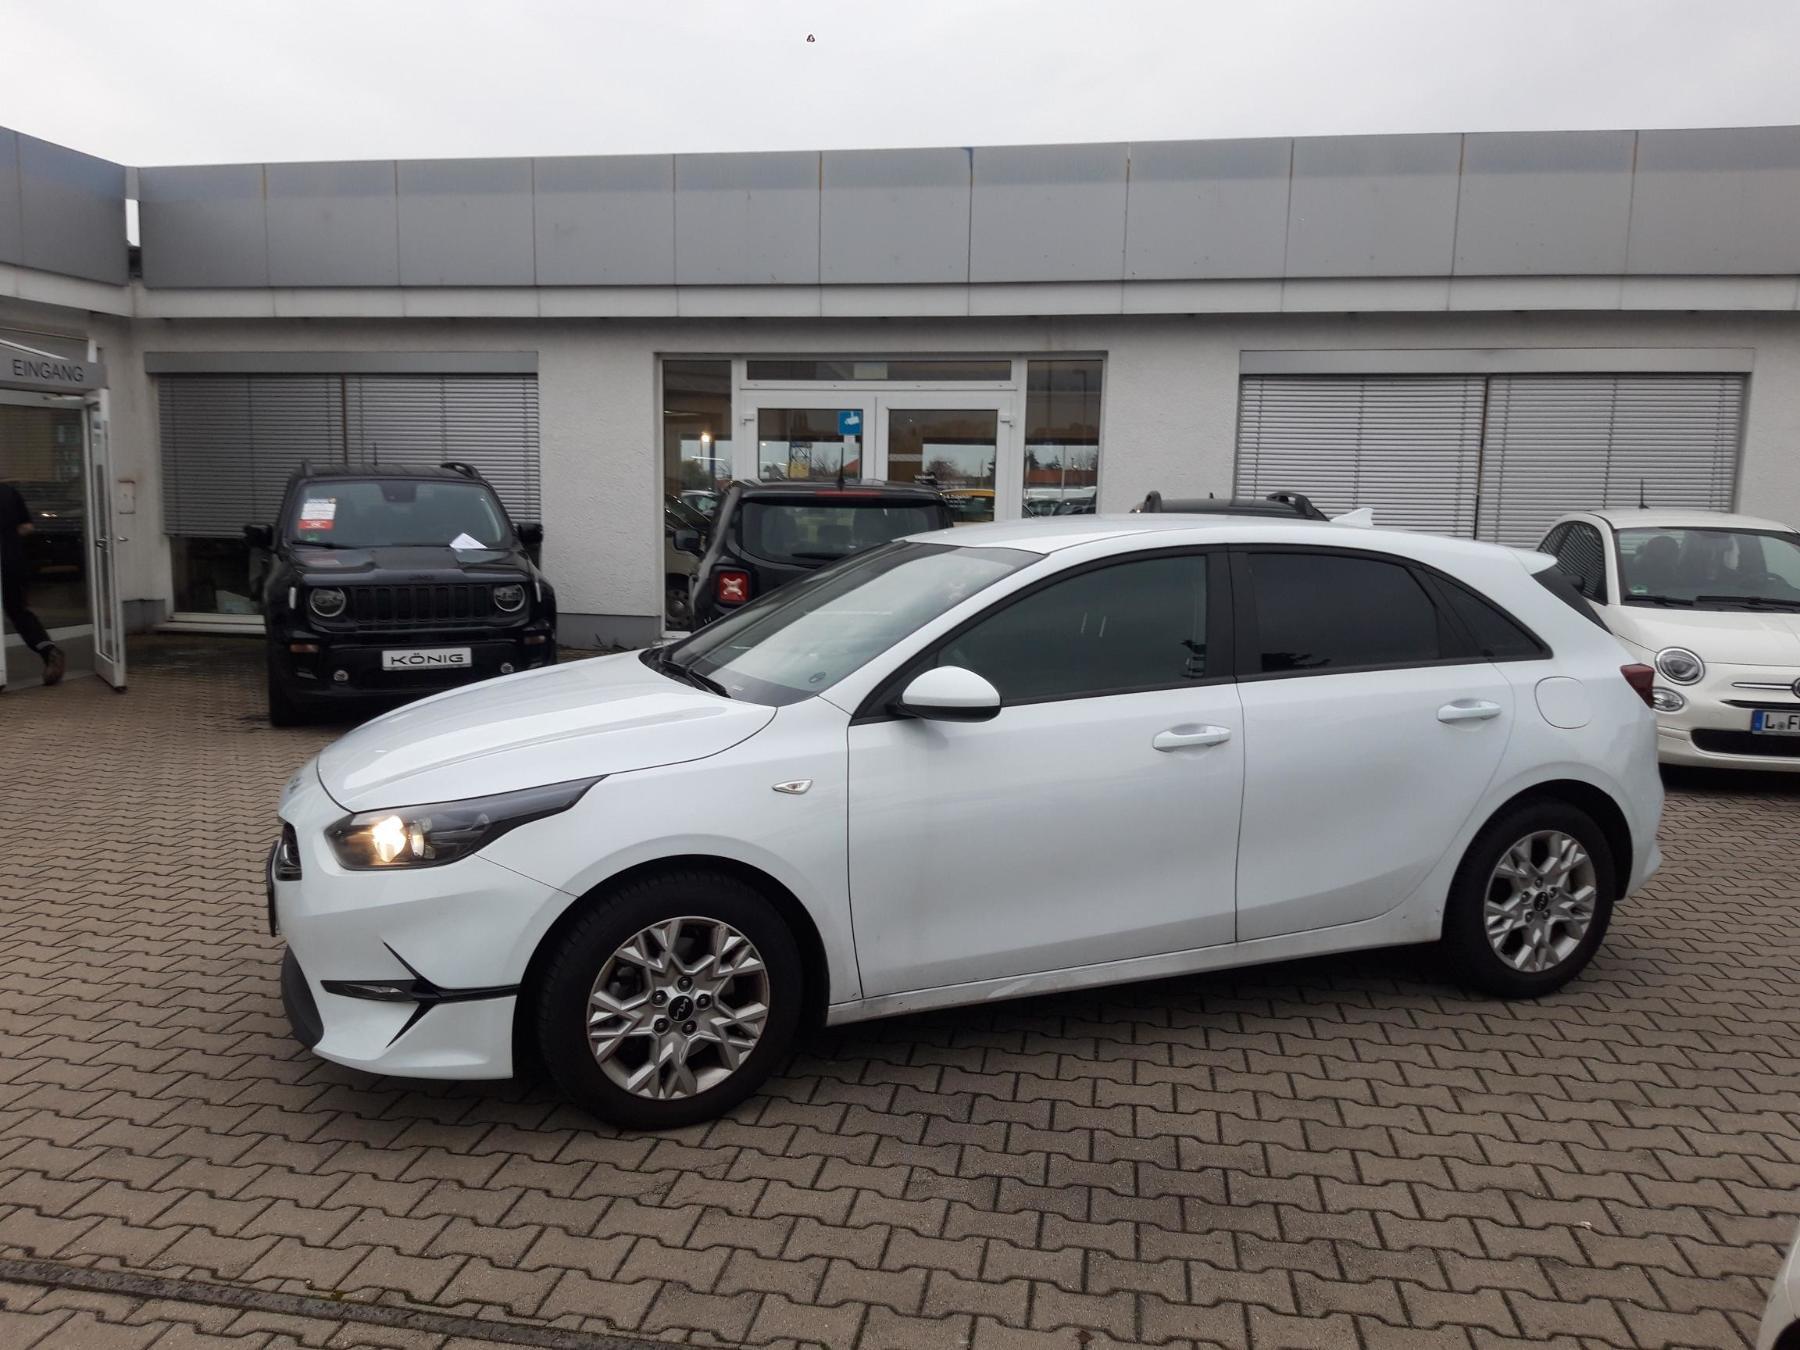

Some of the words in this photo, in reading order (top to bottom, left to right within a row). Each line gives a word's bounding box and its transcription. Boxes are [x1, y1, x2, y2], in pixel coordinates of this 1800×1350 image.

[12, 359, 84, 382] EINGANG
[390, 652, 464, 665] KÖNIG
[1787, 714, 1800, 730] F
